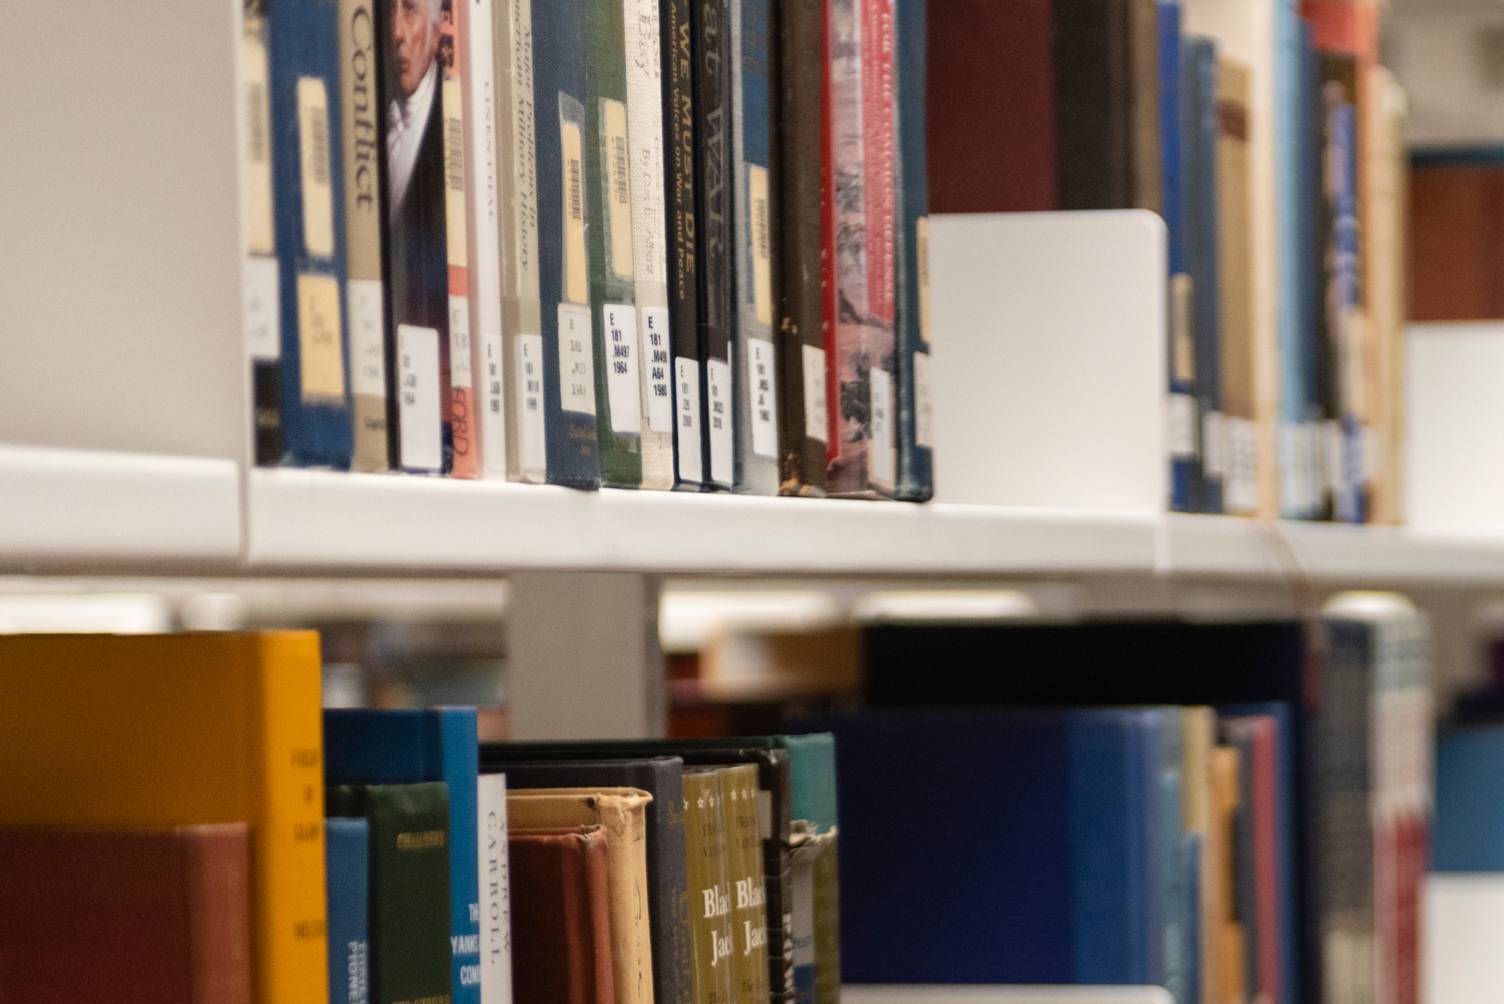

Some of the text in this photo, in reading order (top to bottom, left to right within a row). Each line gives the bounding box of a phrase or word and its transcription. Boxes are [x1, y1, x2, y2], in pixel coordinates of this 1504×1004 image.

[352, 6, 378, 209] Conflict
[516, 96, 527, 184] Military
[523, 27, 537, 228] Major Problems in
[669, 2, 686, 300] American Voices on War and Peace
[679, 22, 695, 274] WE MUST DIE
[707, 104, 724, 258] WAR
[519, 191, 529, 272] History
[883, 215, 895, 302] DEFENSE
[609, 312, 615, 326] E
[611, 329, 622, 342] 181
[648, 316, 654, 329] E
[613, 345, 630, 358] .M497
[650, 333, 662, 346] 181
[613, 361, 628, 374] 1964
[652, 367, 664, 380] A64
[452, 385, 468, 456] FORD
[487, 811, 499, 966] CARROLL
[702, 884, 731, 919] Blac
[735, 874, 765, 909] Blac
[468, 902, 479, 923] TH
[450, 934, 479, 955] YANK
[710, 923, 733, 968] Jac
[743, 914, 767, 957] Jac
[459, 964, 480, 985] COM
